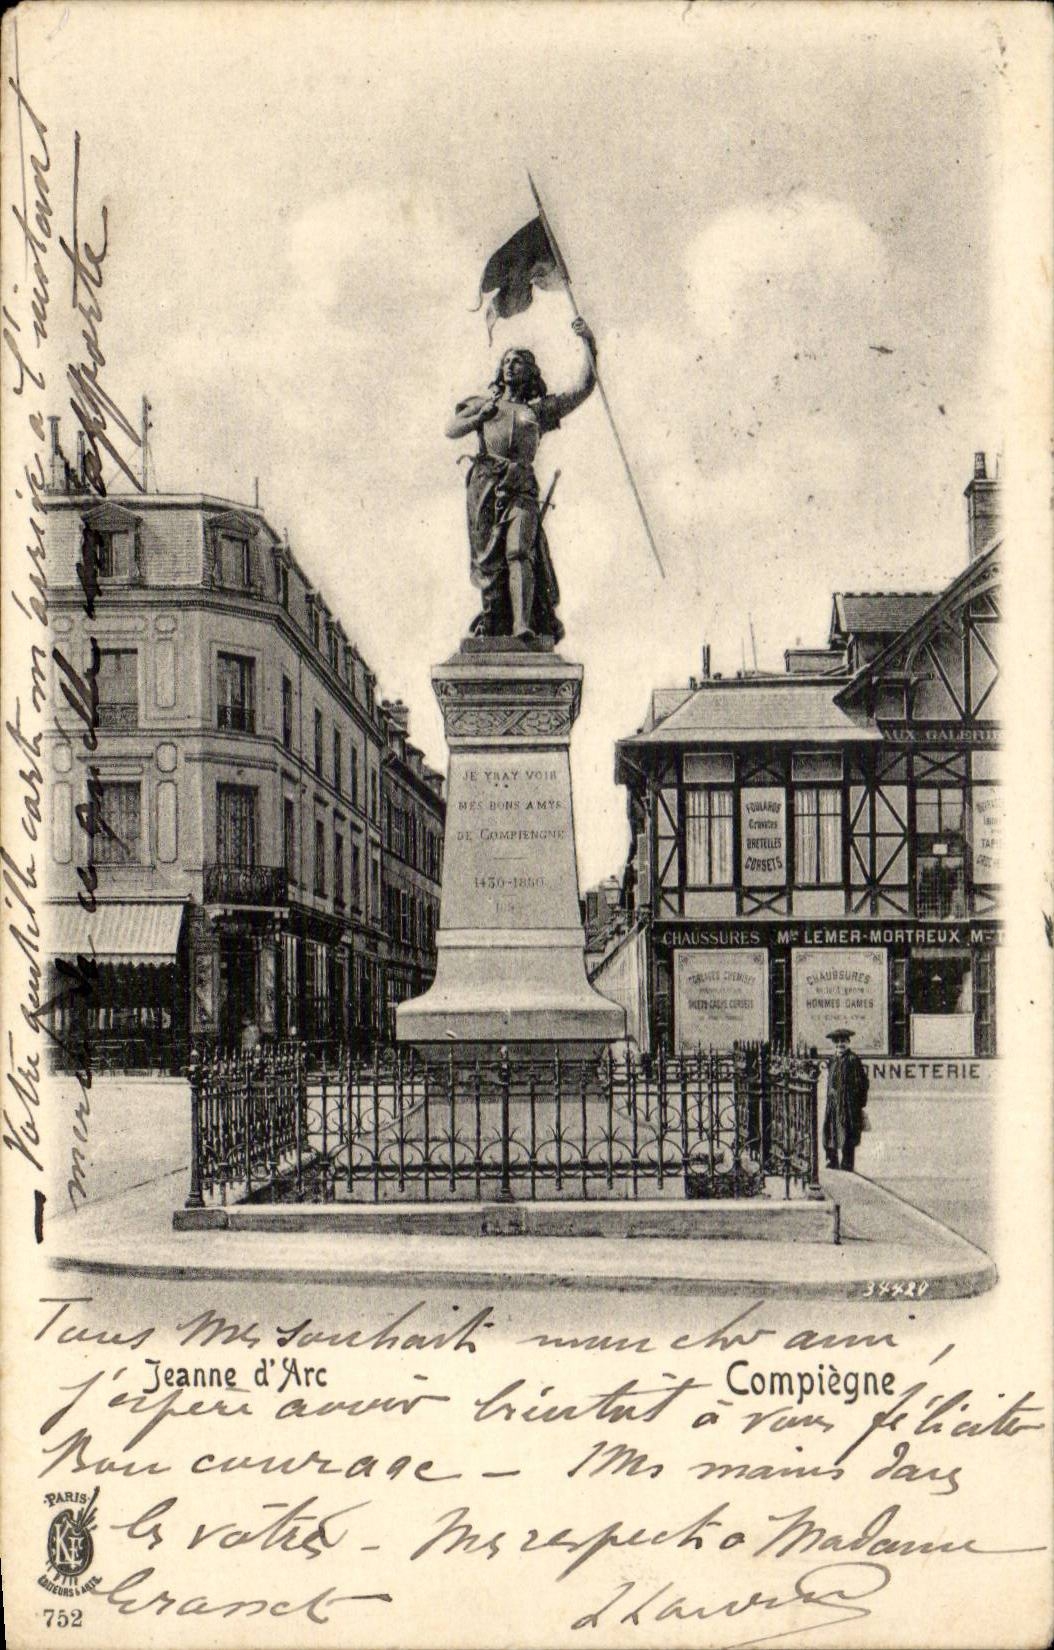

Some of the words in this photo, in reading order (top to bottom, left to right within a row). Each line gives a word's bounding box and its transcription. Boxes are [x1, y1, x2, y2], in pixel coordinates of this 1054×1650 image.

[883, 730, 915, 741] AUX
[463, 771, 477, 781] JE
[485, 771, 518, 781] YRAY
[526, 771, 557, 781] VOIR
[458, 802, 485, 811] MES
[489, 802, 520, 811] BONS
[525, 801, 562, 811] AMYS
[457, 832, 472, 841] DE
[746, 837, 782, 849] BRETELLES
[744, 855, 783, 872] CORSETS
[662, 930, 760, 945] CHAUSSURES
[804, 930, 960, 944] LEMER-MORTREUX
[806, 970, 871, 986] CHAUSSURES
[806, 998, 841, 1009] HOMMES
[845, 998, 875, 1009] DAMES
